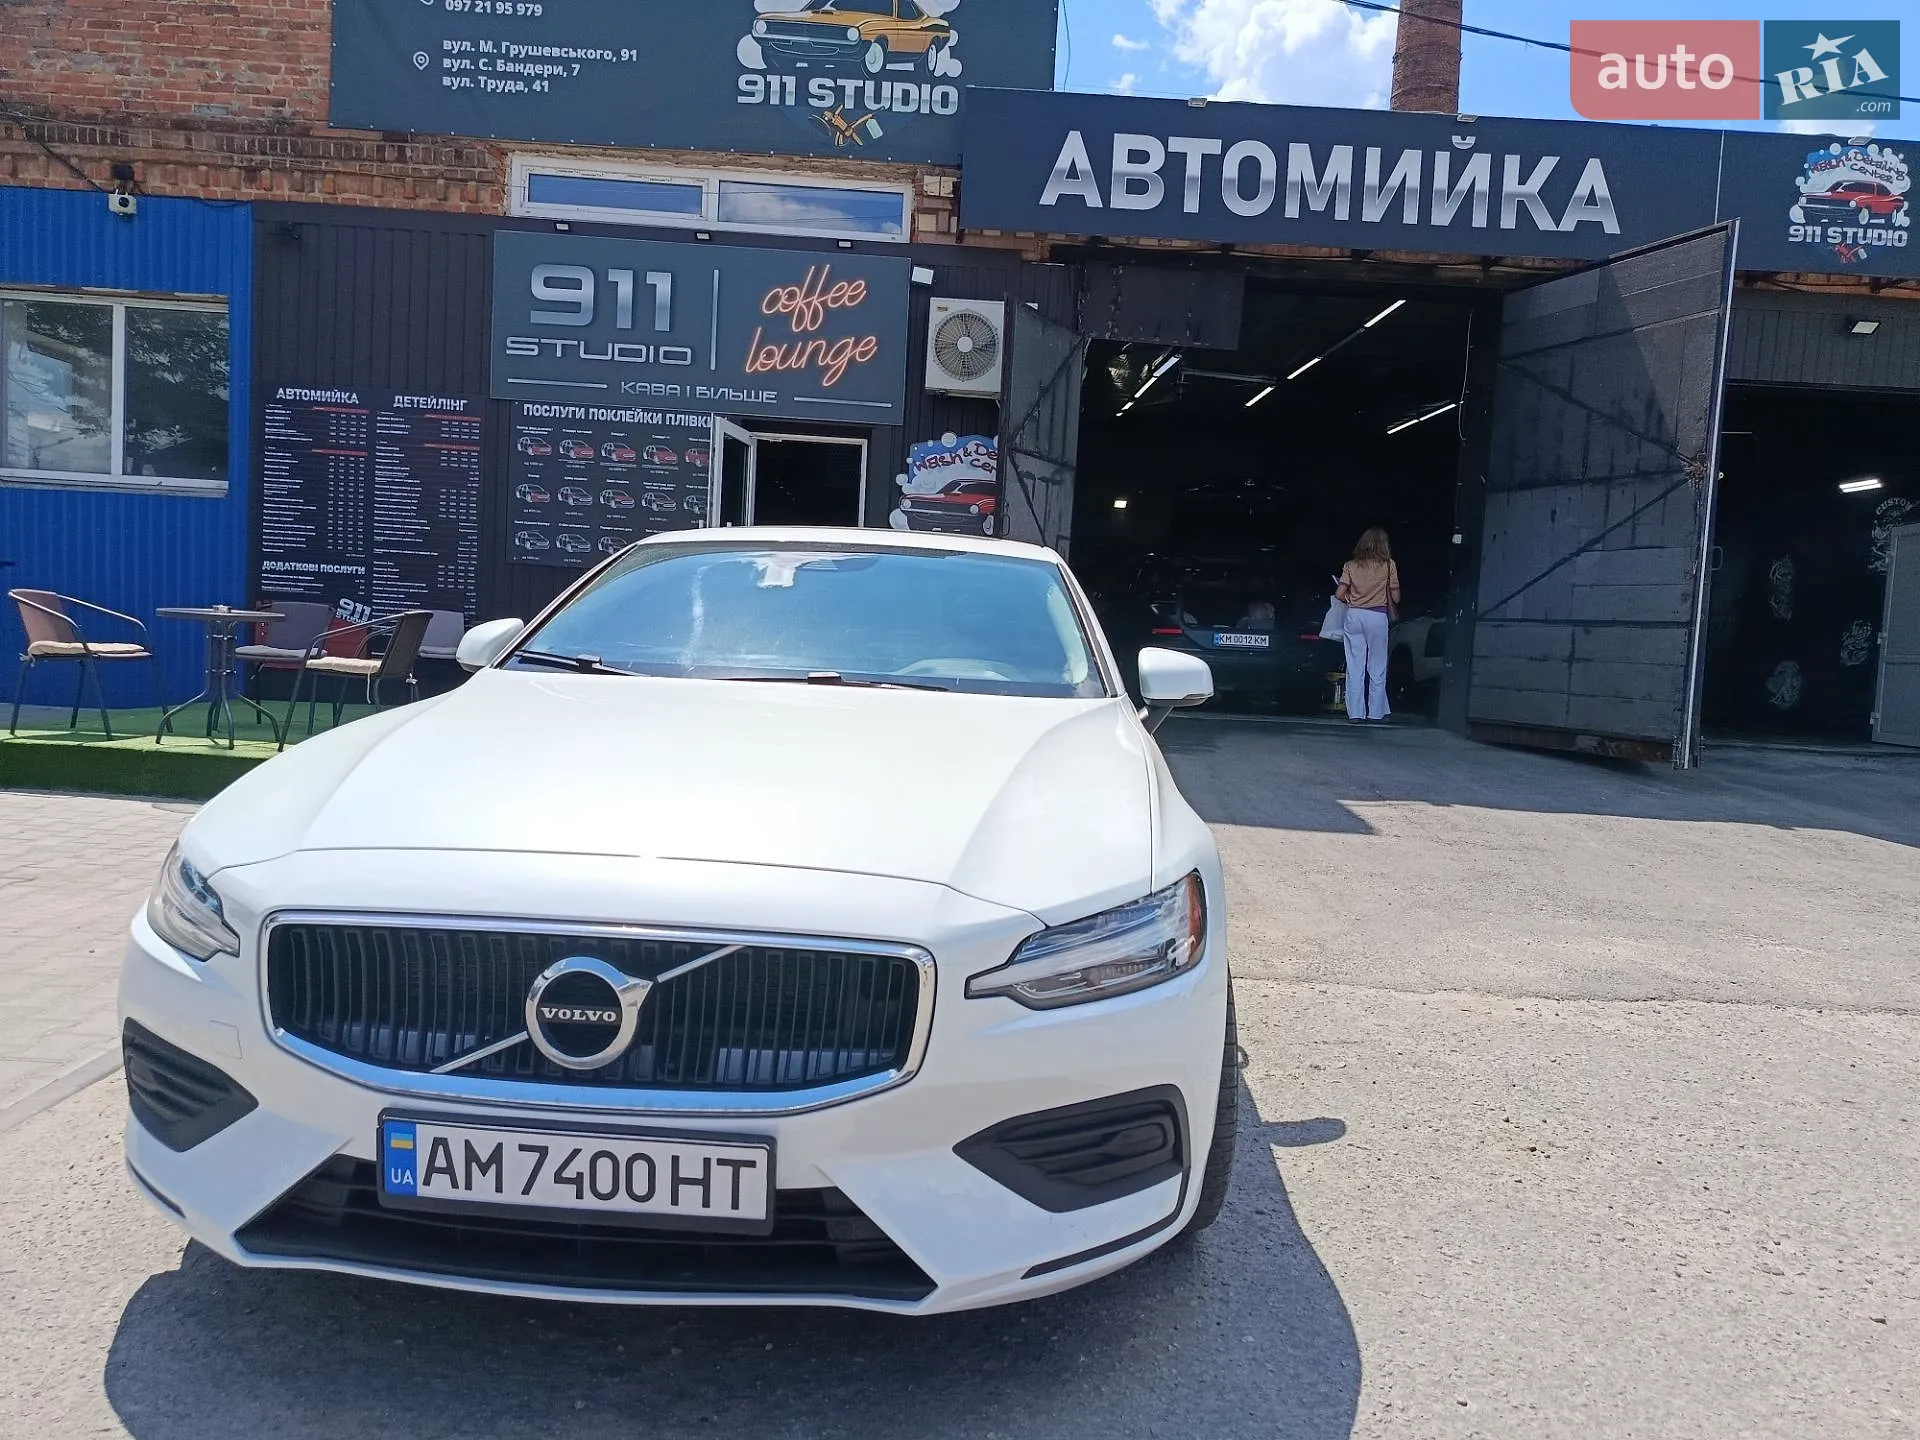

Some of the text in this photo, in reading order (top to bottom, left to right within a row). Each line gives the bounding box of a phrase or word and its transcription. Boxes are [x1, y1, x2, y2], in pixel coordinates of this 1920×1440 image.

[475, 1, 492, 13] 21
[496, 2, 513, 15] 95
[516, 4, 543, 17] 979
[442, 40, 638, 62] вул. М. Грушевського, 91
[442, 57, 581, 77] вул. С. Бандери, 7
[442, 75, 549, 93] вул. Труда, 41
[737, 73, 959, 116] 911 STUDIO
[1039, 130, 1622, 235] АВТОМИЙКА
[1788, 225, 1908, 248] 911 STUDIO
[529, 263, 673, 333] 911
[761, 263, 868, 333] coffee
[505, 336, 692, 367] STUDIO
[744, 326, 878, 388] lounge
[276, 387, 360, 404] АВТОМИЙКА
[393, 395, 469, 412] ДЕТЕЙЛІНГ
[621, 381, 680, 399] КАВА
[695, 386, 777, 404] БІЛЬШЕ
[523, 403, 585, 420] ПОСЛУГИ
[588, 408, 662, 424] ПОКЛЕЙКИ
[262, 561, 365, 575] ДОДАТКОВІ ПОСЛУГИ
[339, 598, 372, 622] 911
[540, 1007, 617, 1023] VOLVO
[391, 1168, 414, 1186] UA
[422, 1136, 757, 1211] AM 7400 HT
